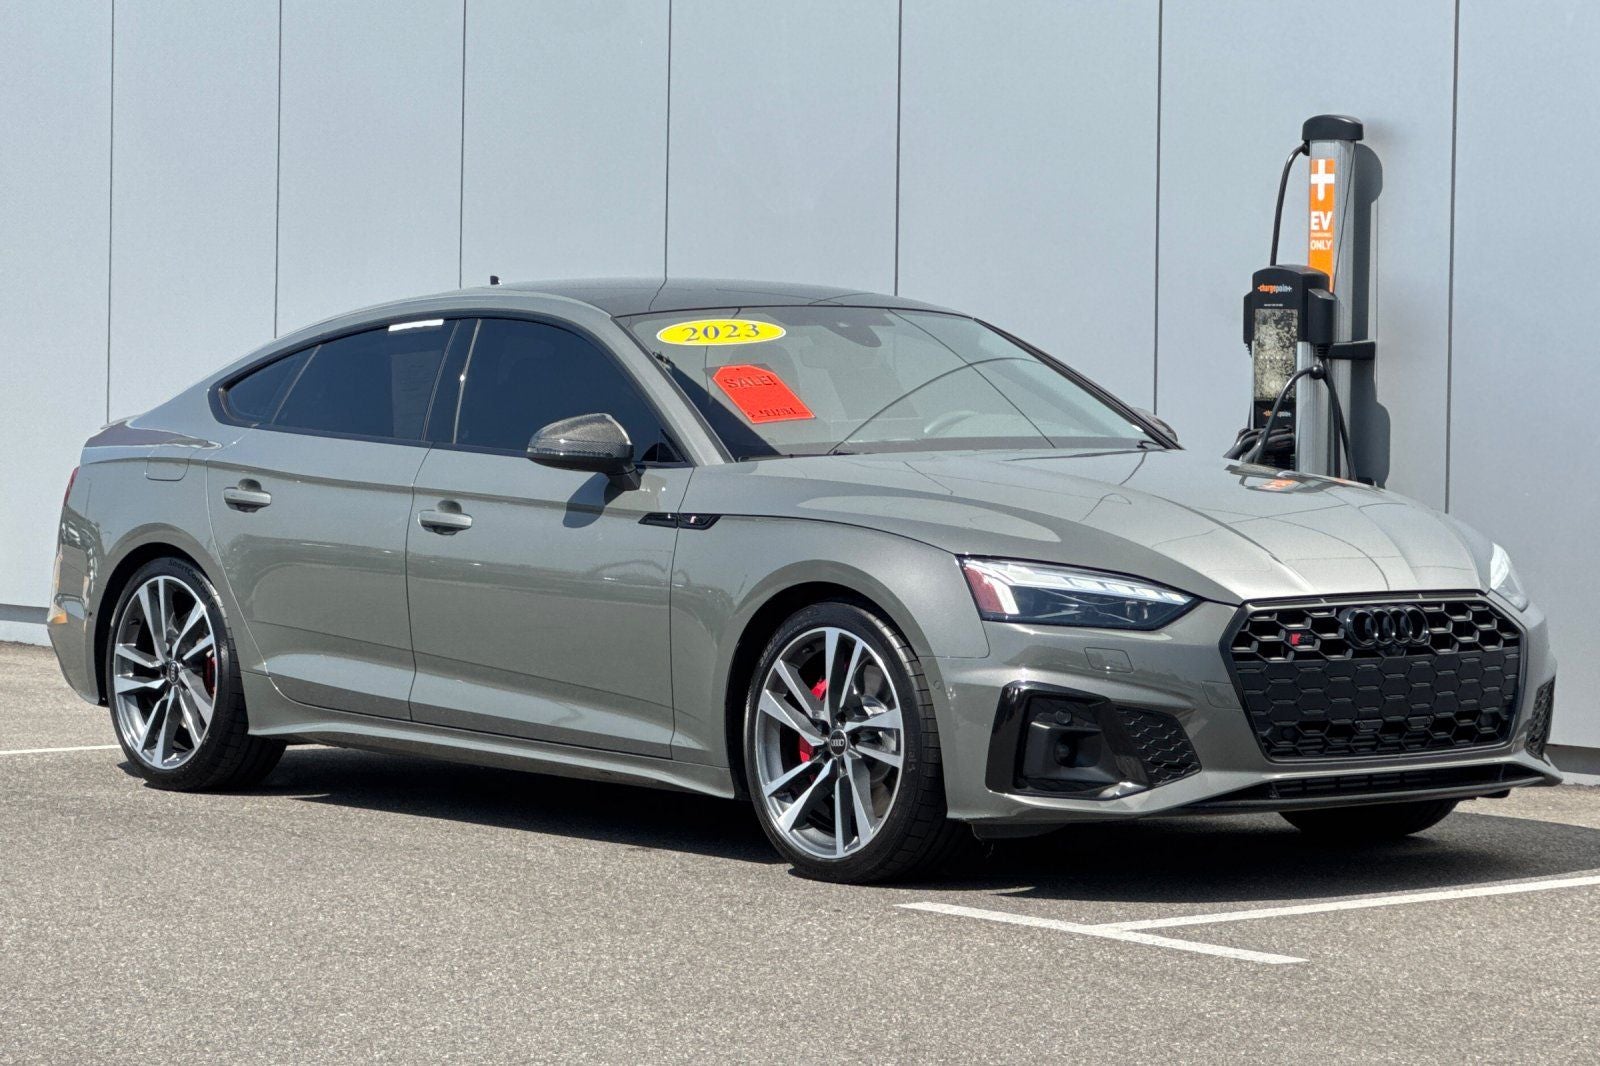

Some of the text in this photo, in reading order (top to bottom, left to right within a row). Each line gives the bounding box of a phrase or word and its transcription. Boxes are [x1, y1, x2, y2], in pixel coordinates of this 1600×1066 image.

[1310, 211, 1333, 230] EV
[1310, 240, 1332, 250] ONLY
[682, 323, 760, 342] 2023
[724, 375, 777, 388] SALE!
